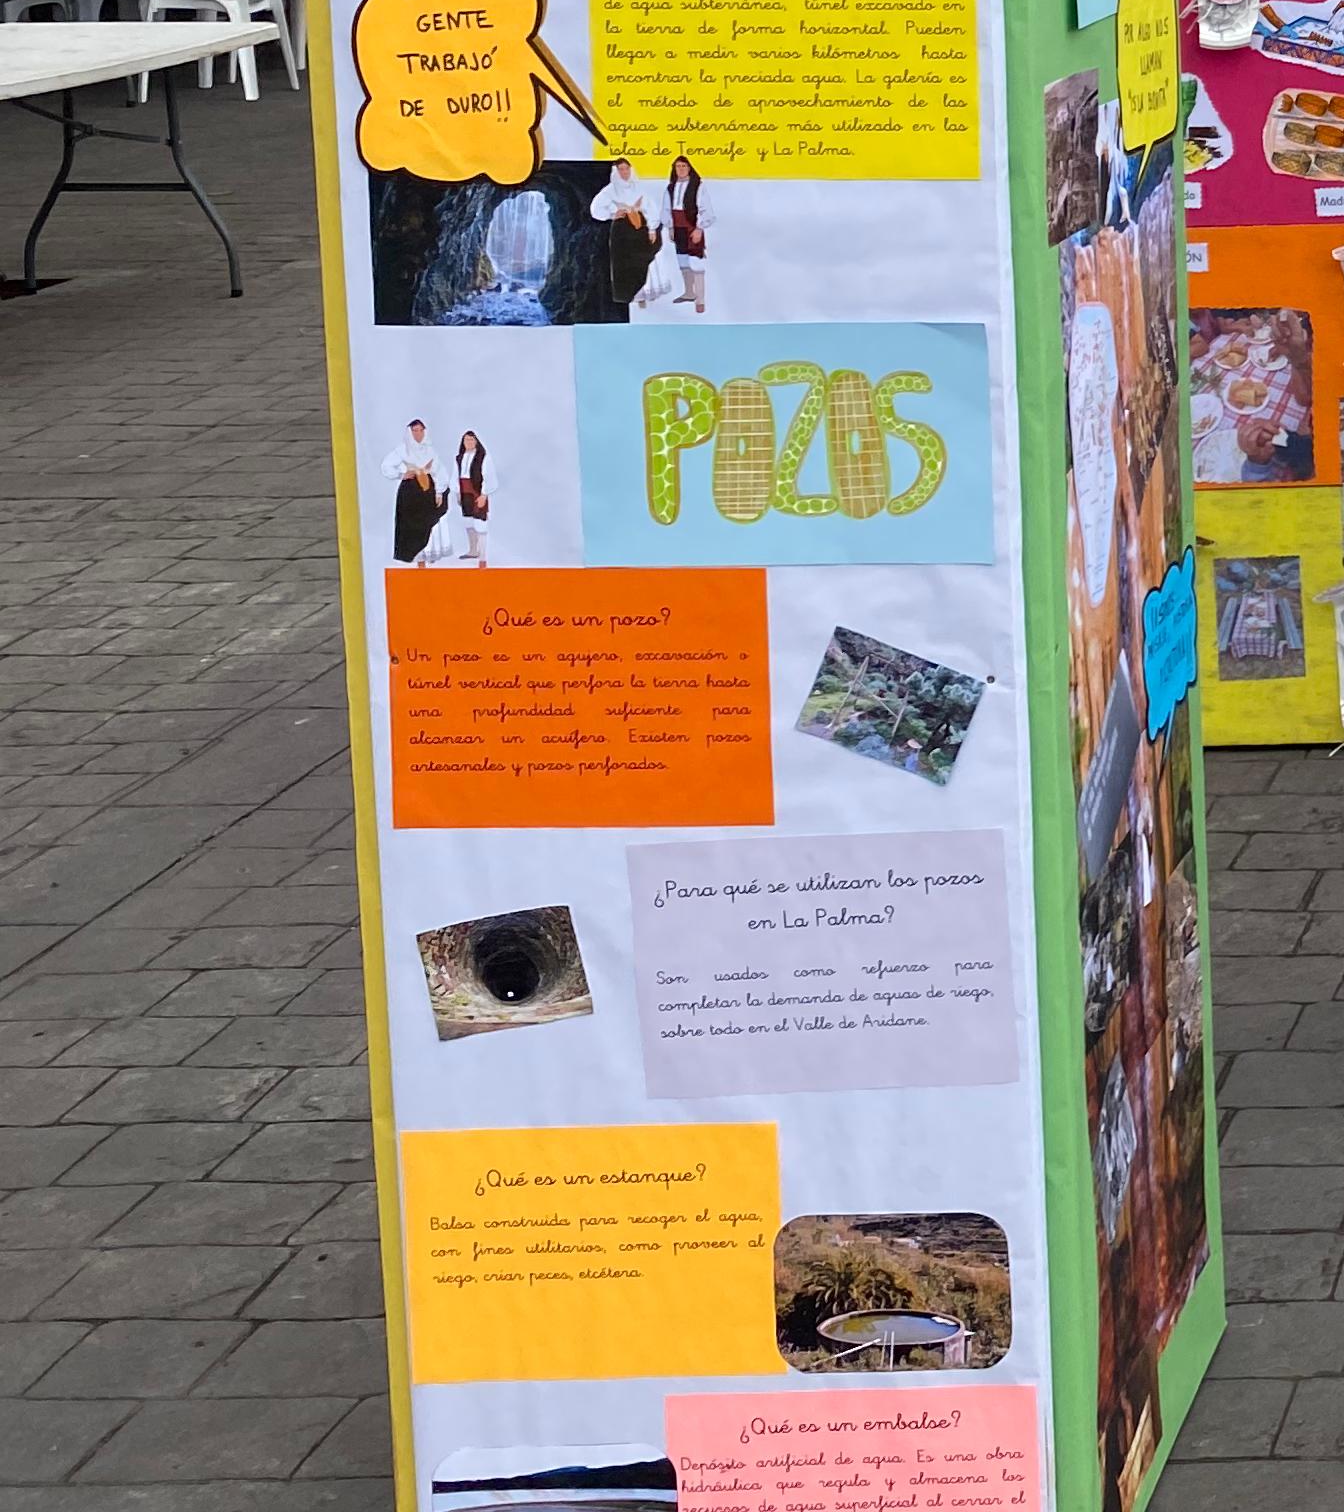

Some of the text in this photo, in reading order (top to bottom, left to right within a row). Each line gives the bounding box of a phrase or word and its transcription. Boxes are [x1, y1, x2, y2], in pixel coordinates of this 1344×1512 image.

[415, 9, 494, 32] GENTE
[397, 46, 501, 78] TRABAJÓ
[399, 88, 512, 123] DE DURO!!
[641, 360, 948, 526] POZOS
[482, 607, 671, 635] ¿Qué es un pozo?
[654, 869, 984, 908] ¿Para qué se utilizan los pozos
[748, 905, 894, 929] en La Palma?
[475, 1163, 706, 1196] ¿Qué es un estanque?
[740, 1410, 960, 1444] ¿Qué es un embalse?
